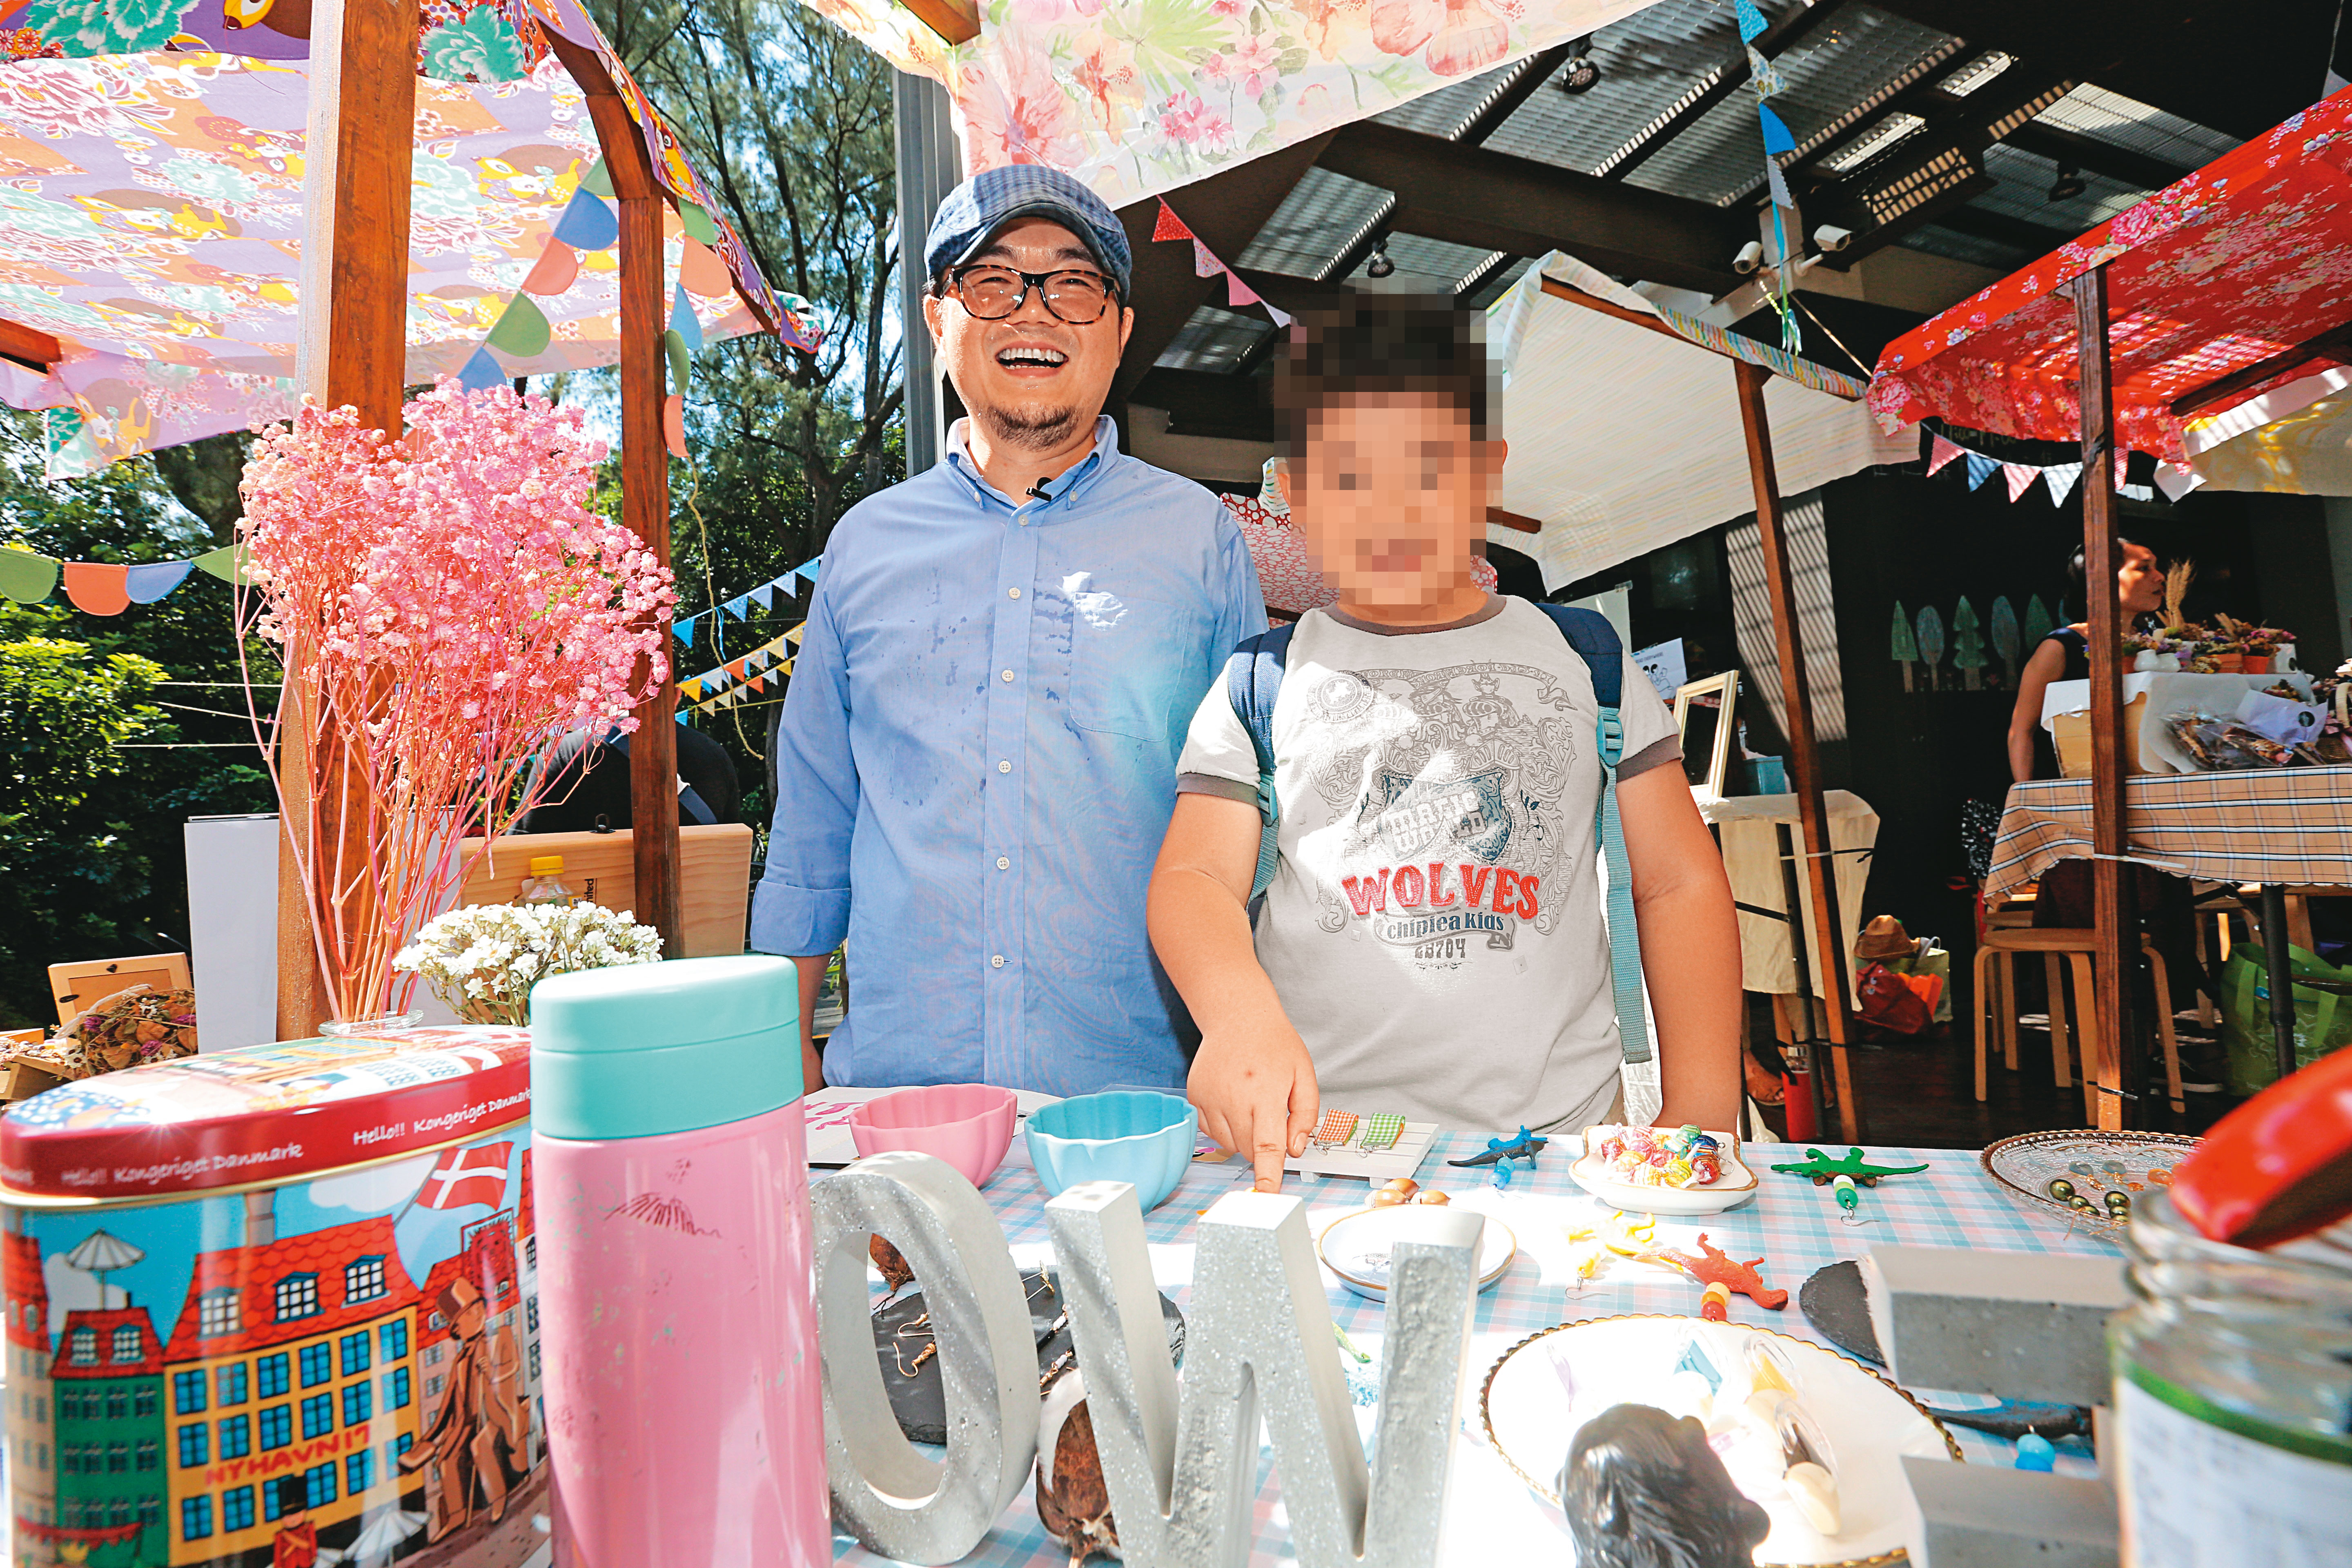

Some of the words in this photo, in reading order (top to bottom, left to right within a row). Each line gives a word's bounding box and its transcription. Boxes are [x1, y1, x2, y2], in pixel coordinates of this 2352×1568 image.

[1341, 861, 1539, 920] WOLVES
[353, 1122, 406, 1146] Hello!!
[413, 1103, 487, 1134] Kongeriget
[488, 1087, 531, 1113] Danmark
[114, 1156, 211, 1185] Kongeriget
[212, 1142, 304, 1170] Danmark
